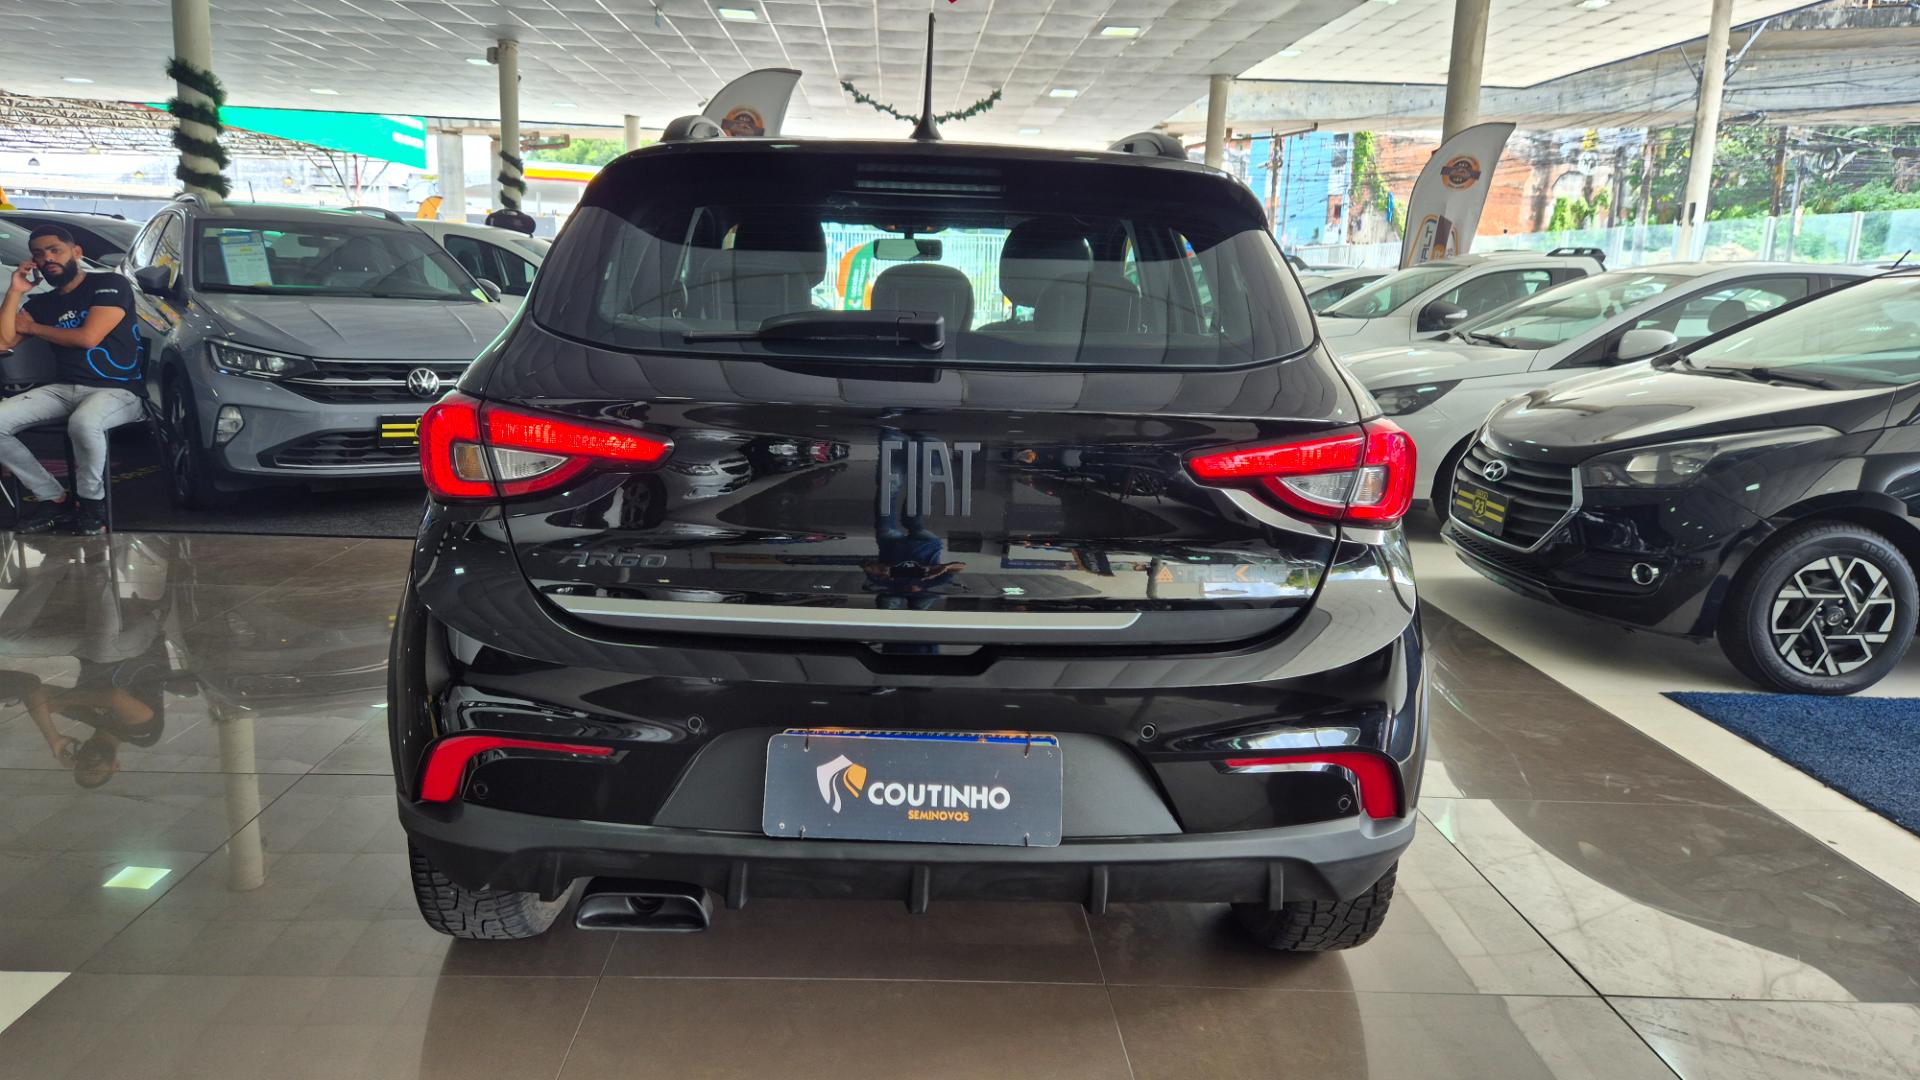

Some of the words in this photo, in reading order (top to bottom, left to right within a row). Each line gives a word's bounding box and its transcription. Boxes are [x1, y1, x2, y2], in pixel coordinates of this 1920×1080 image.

[880, 440, 981, 516] FIAT
[558, 552, 667, 568] ARGO
[867, 782, 1011, 810] COUTINHO
[908, 810, 970, 822] SEMINOVOS
